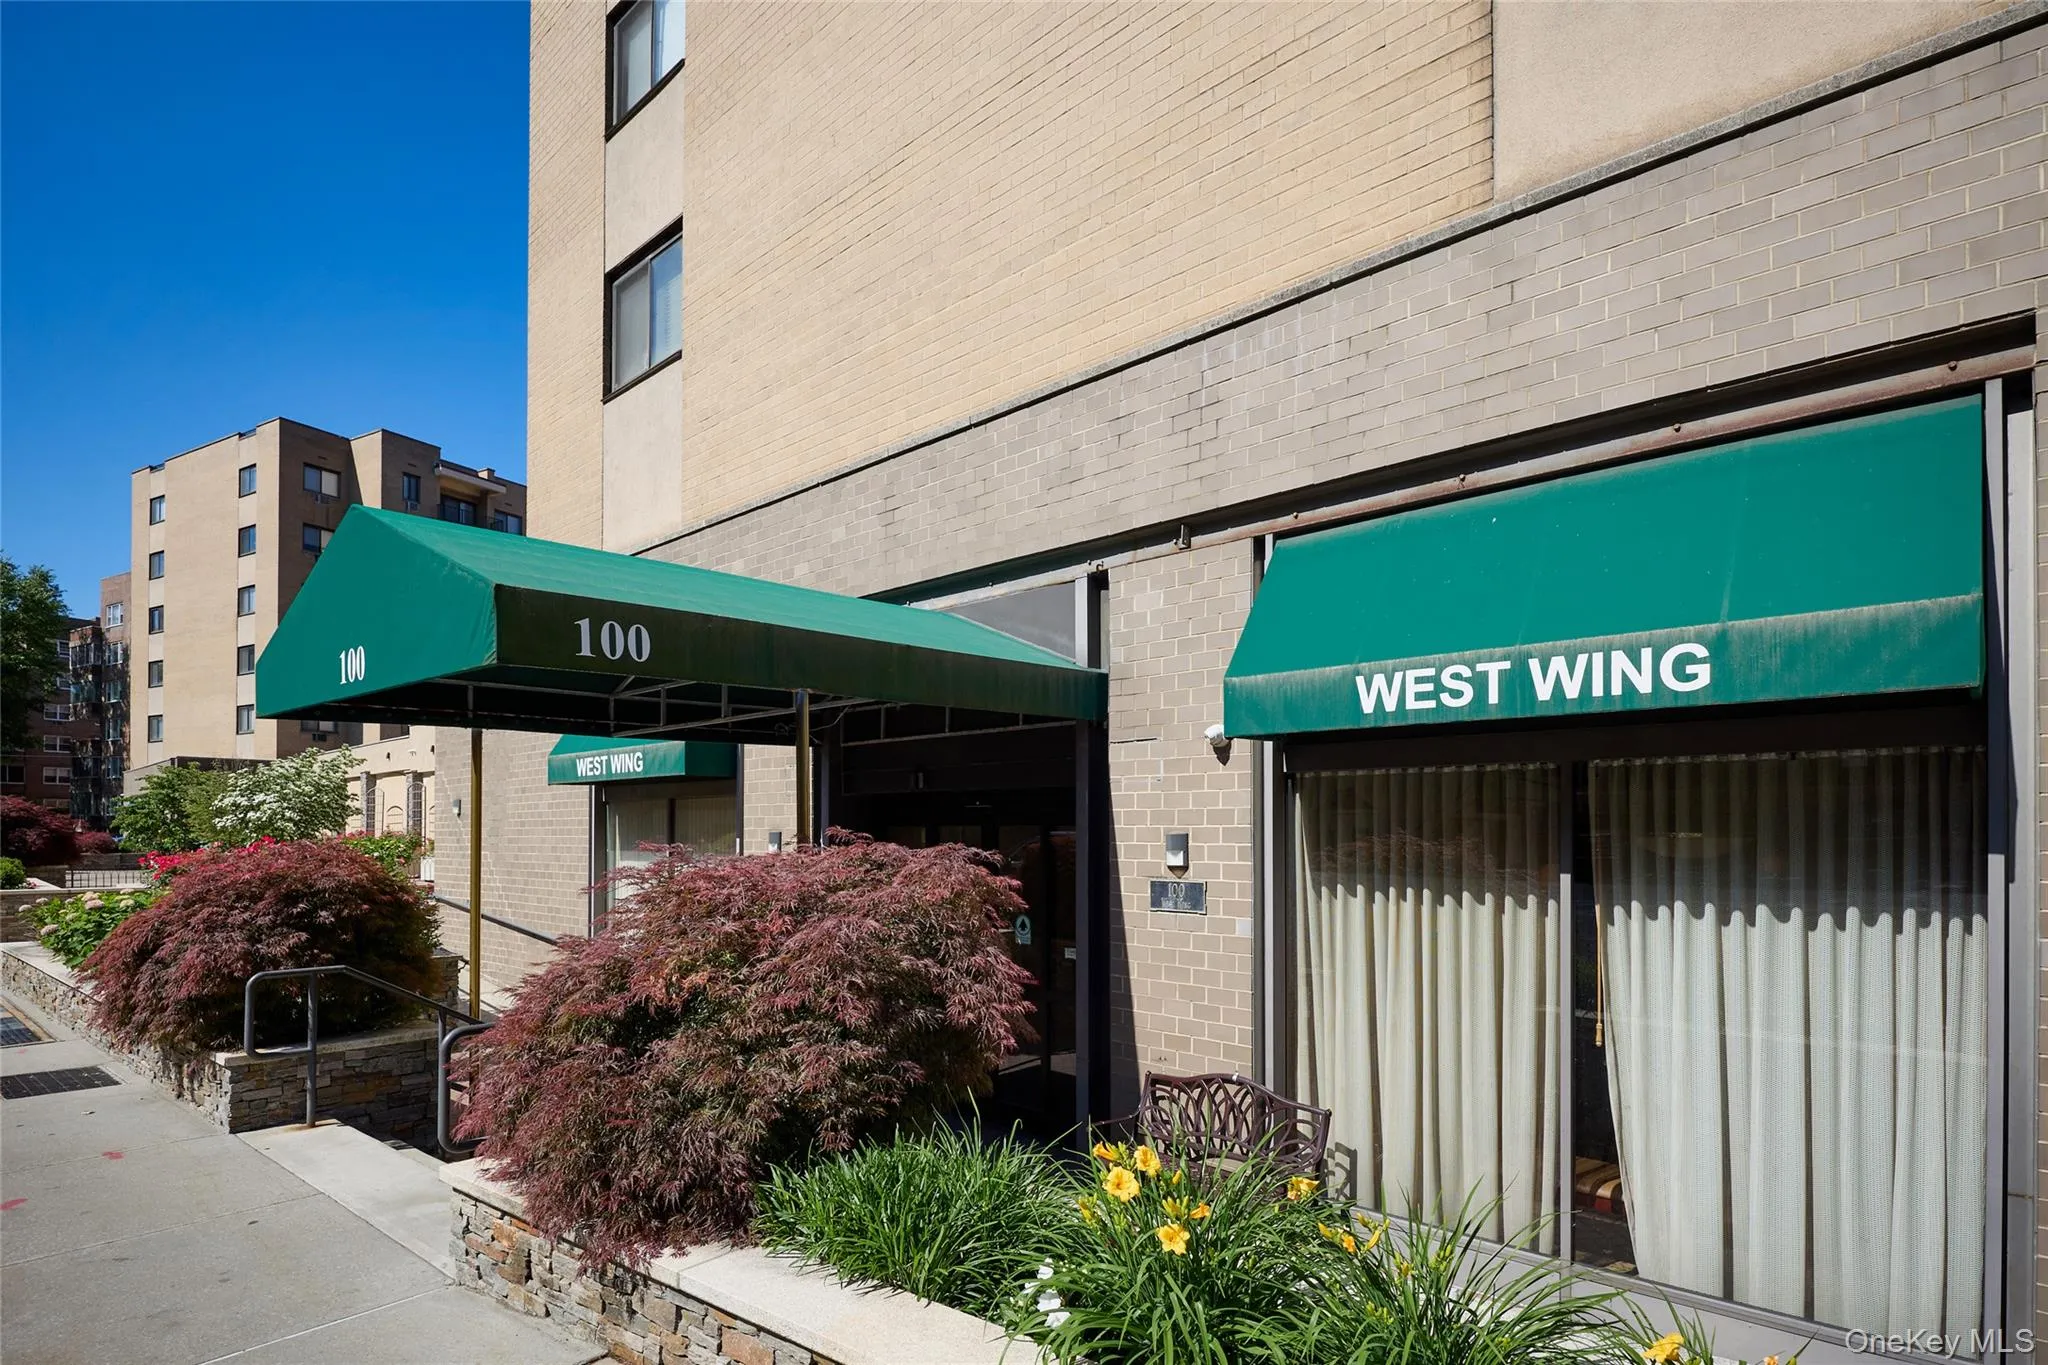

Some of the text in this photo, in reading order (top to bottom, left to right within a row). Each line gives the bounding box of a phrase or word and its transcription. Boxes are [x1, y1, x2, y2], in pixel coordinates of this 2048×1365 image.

[574, 617, 651, 663] 100
[339, 645, 366, 685] 100
[1355, 642, 1711, 714] WEST WING
[576, 751, 643, 777] WEST WING
